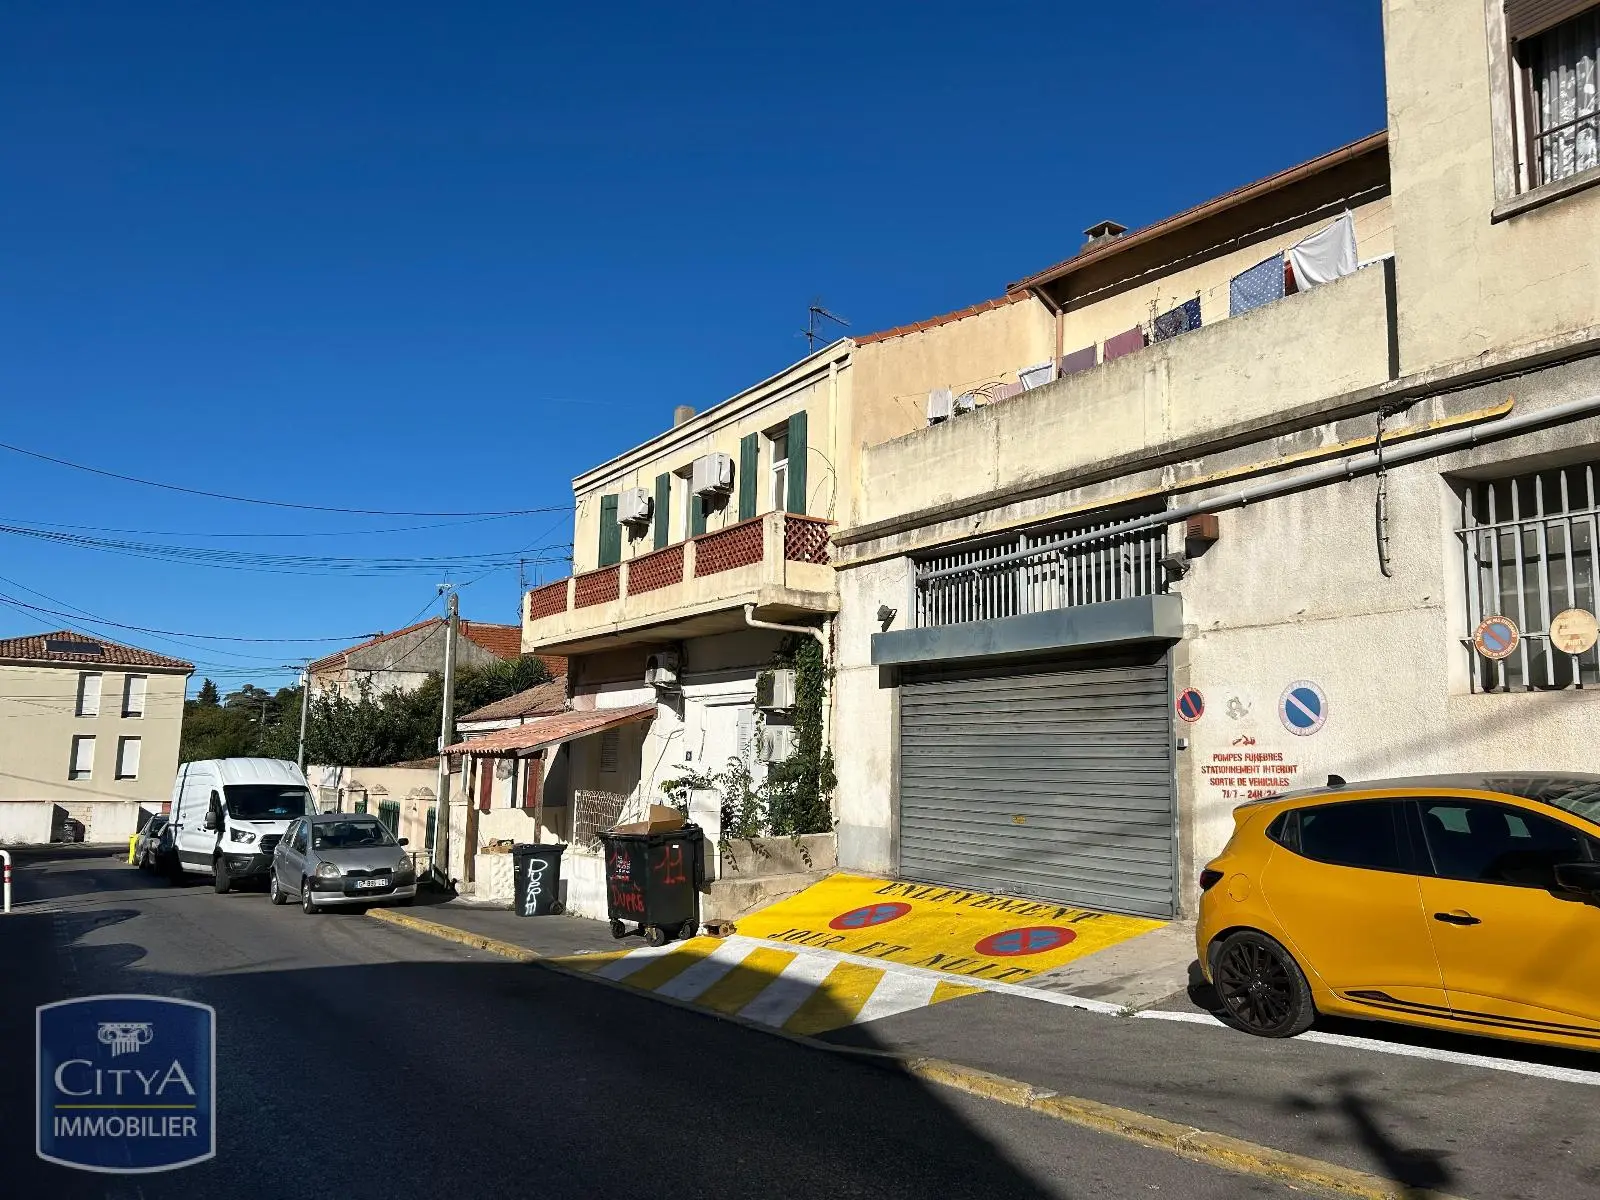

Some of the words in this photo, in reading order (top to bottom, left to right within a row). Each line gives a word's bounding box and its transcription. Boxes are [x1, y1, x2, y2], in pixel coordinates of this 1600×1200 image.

[1213, 753, 1243, 762] POMPES
[1201, 765, 1260, 775] STATIONNEMENT
[1263, 764, 1298, 774] INTERDIT
[1209, 777, 1235, 787] SORTIE
[1237, 777, 1247, 787] DE
[1248, 777, 1290, 787] VEHICULES
[874, 882, 1105, 924] ENLEVEMENT
[766, 928, 847, 948] JOUR
[850, 941, 912, 958] ET
[913, 953, 1032, 981] NUIT
